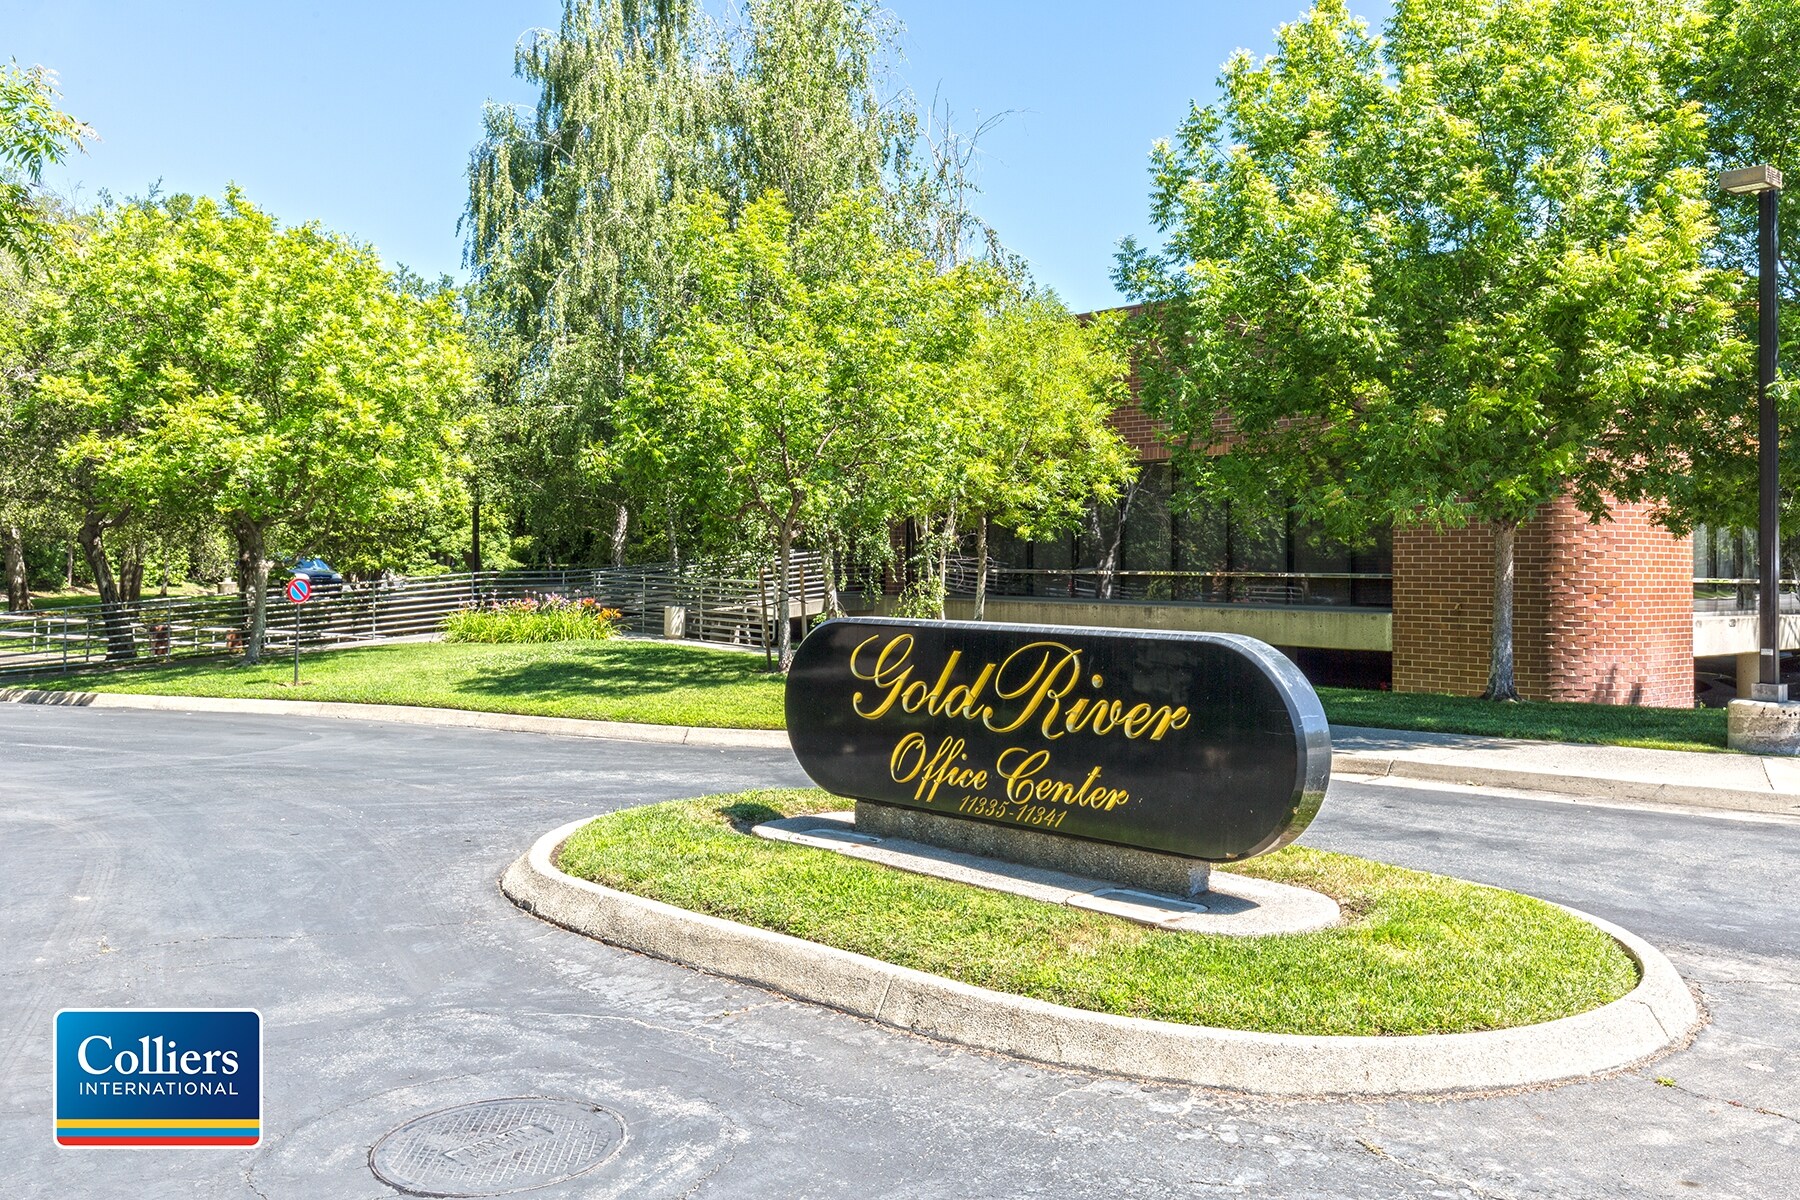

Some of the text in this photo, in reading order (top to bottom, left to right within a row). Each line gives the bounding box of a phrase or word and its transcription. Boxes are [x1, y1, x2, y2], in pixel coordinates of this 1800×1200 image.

[850, 633, 1191, 741] Gold River
[890, 732, 1130, 812] Office Center
[958, 795, 1068, 828] 11335-11341
